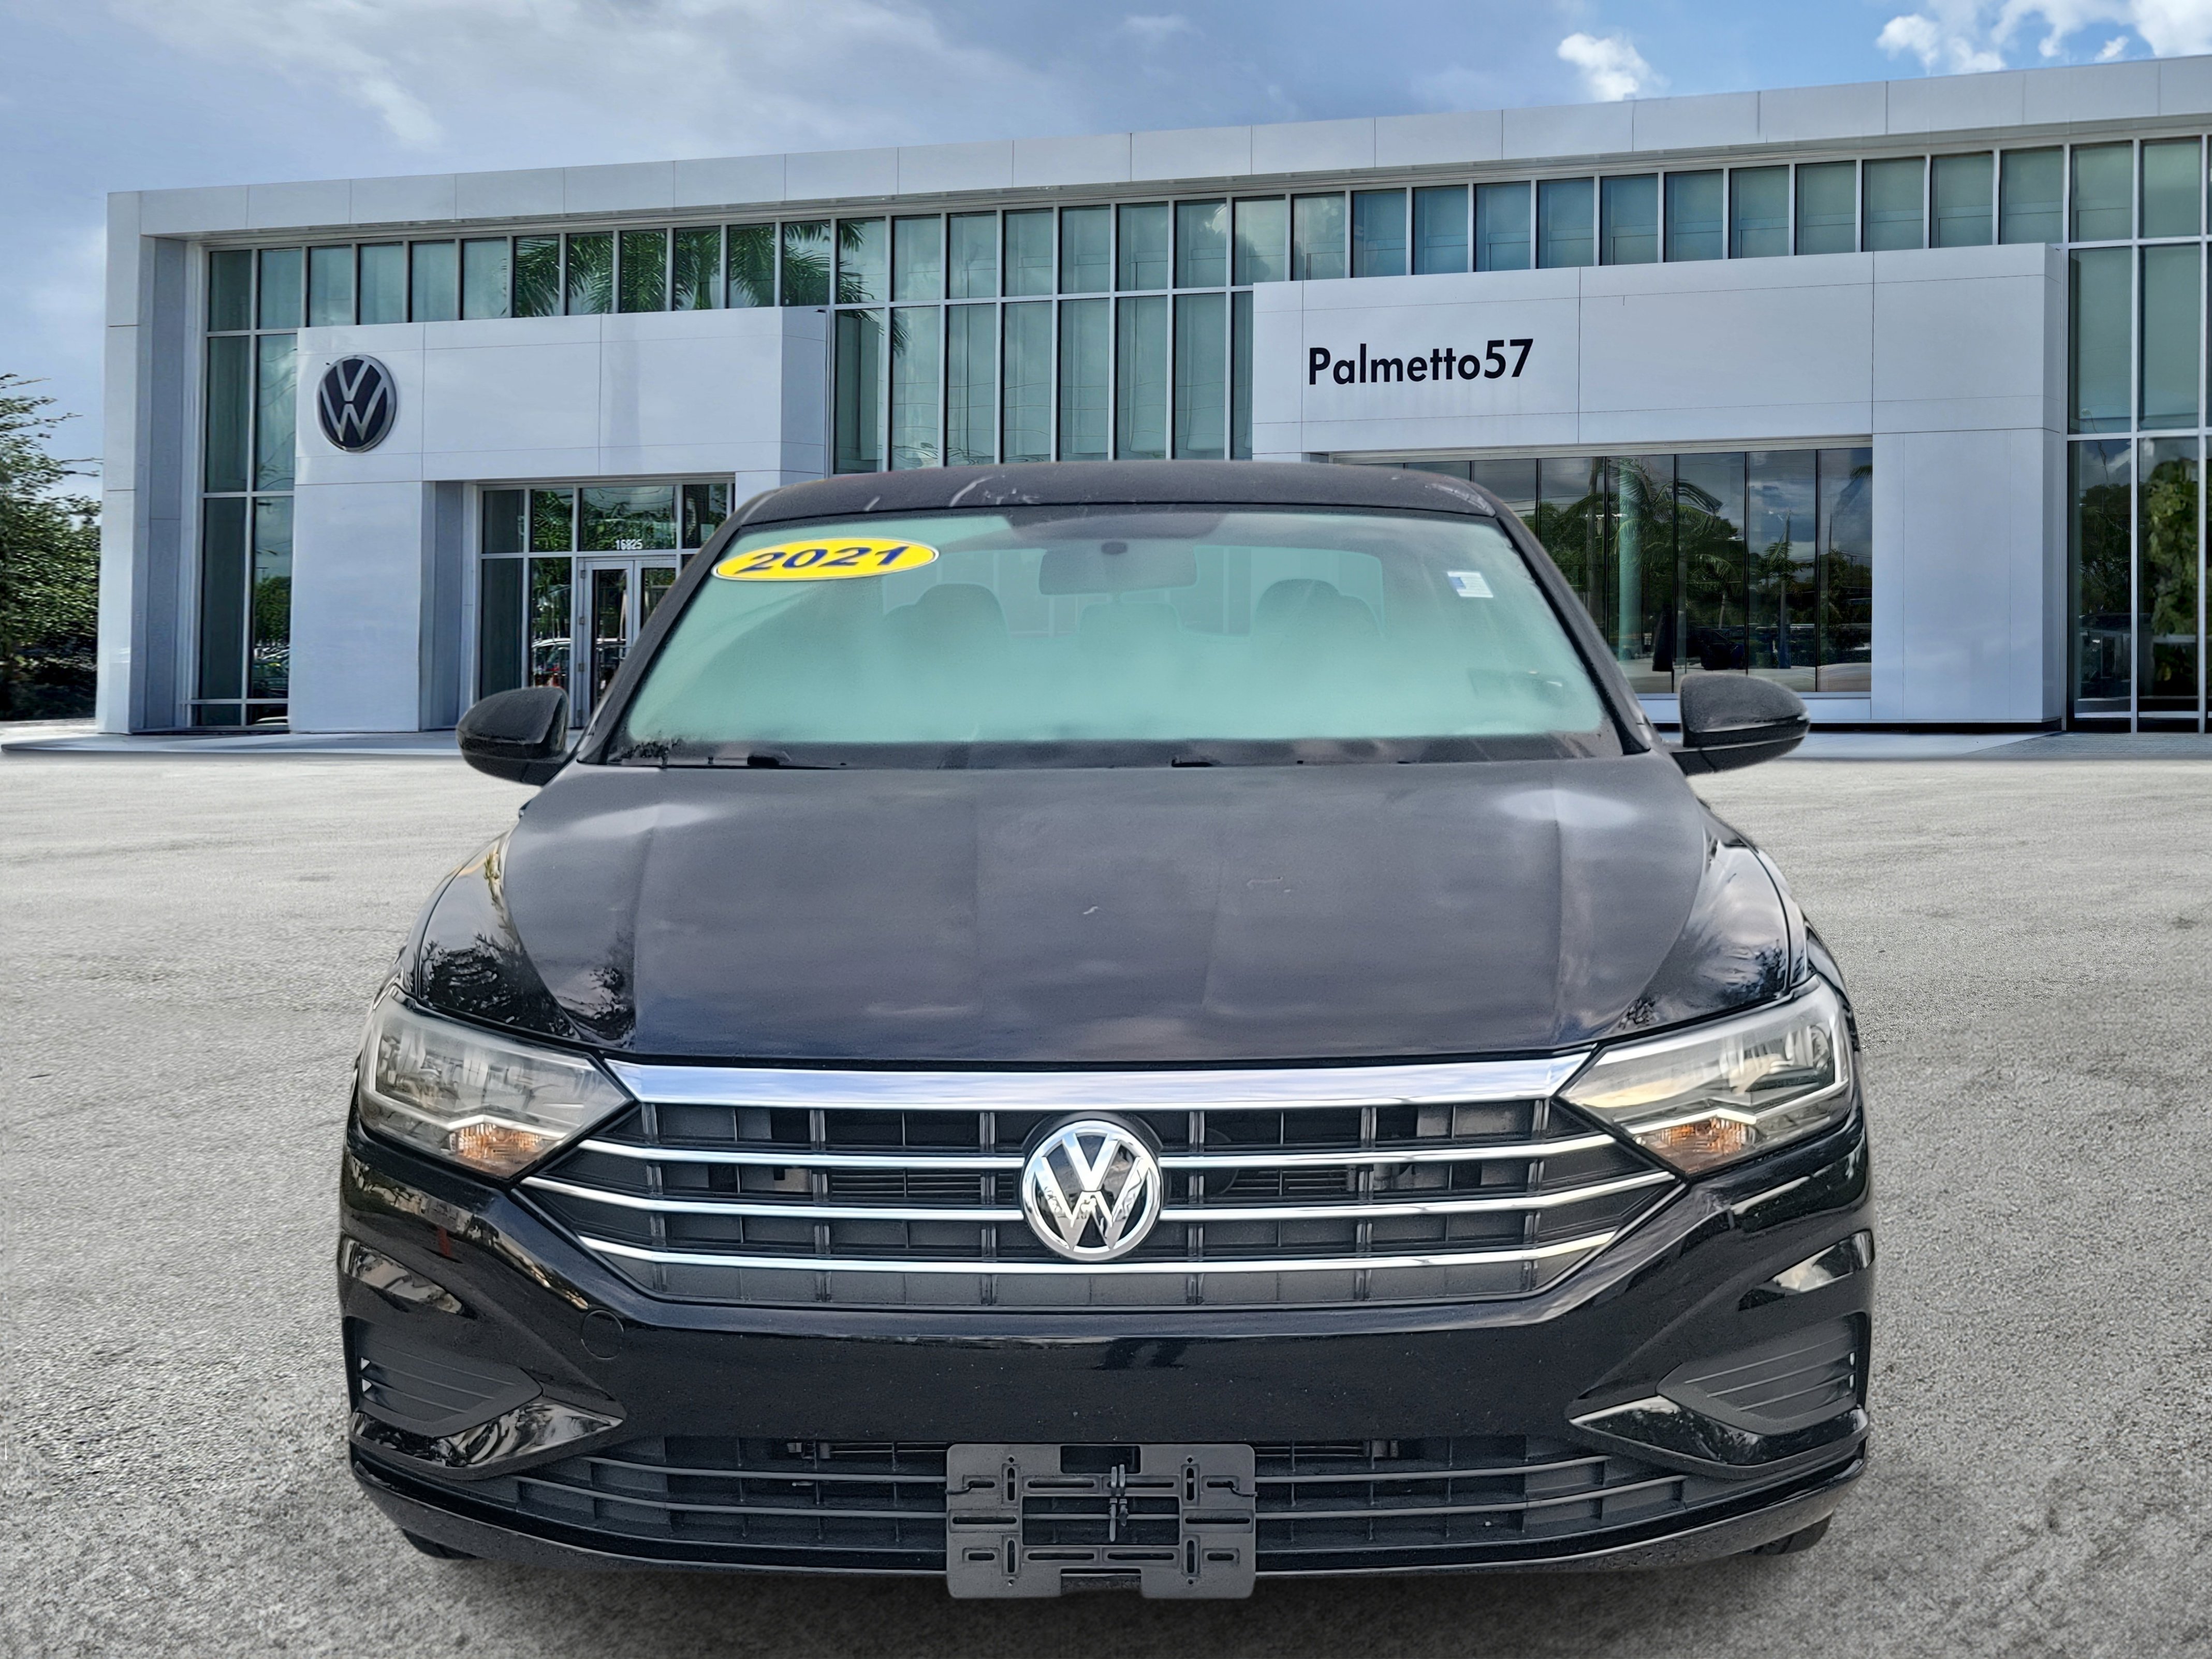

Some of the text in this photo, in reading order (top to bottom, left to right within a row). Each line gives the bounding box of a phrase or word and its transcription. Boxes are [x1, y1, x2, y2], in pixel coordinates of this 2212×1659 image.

[1309, 338, 1534, 385] Palmetto57
[733, 546, 910, 575] 2021
[1027, 1125, 1155, 1255] VW
